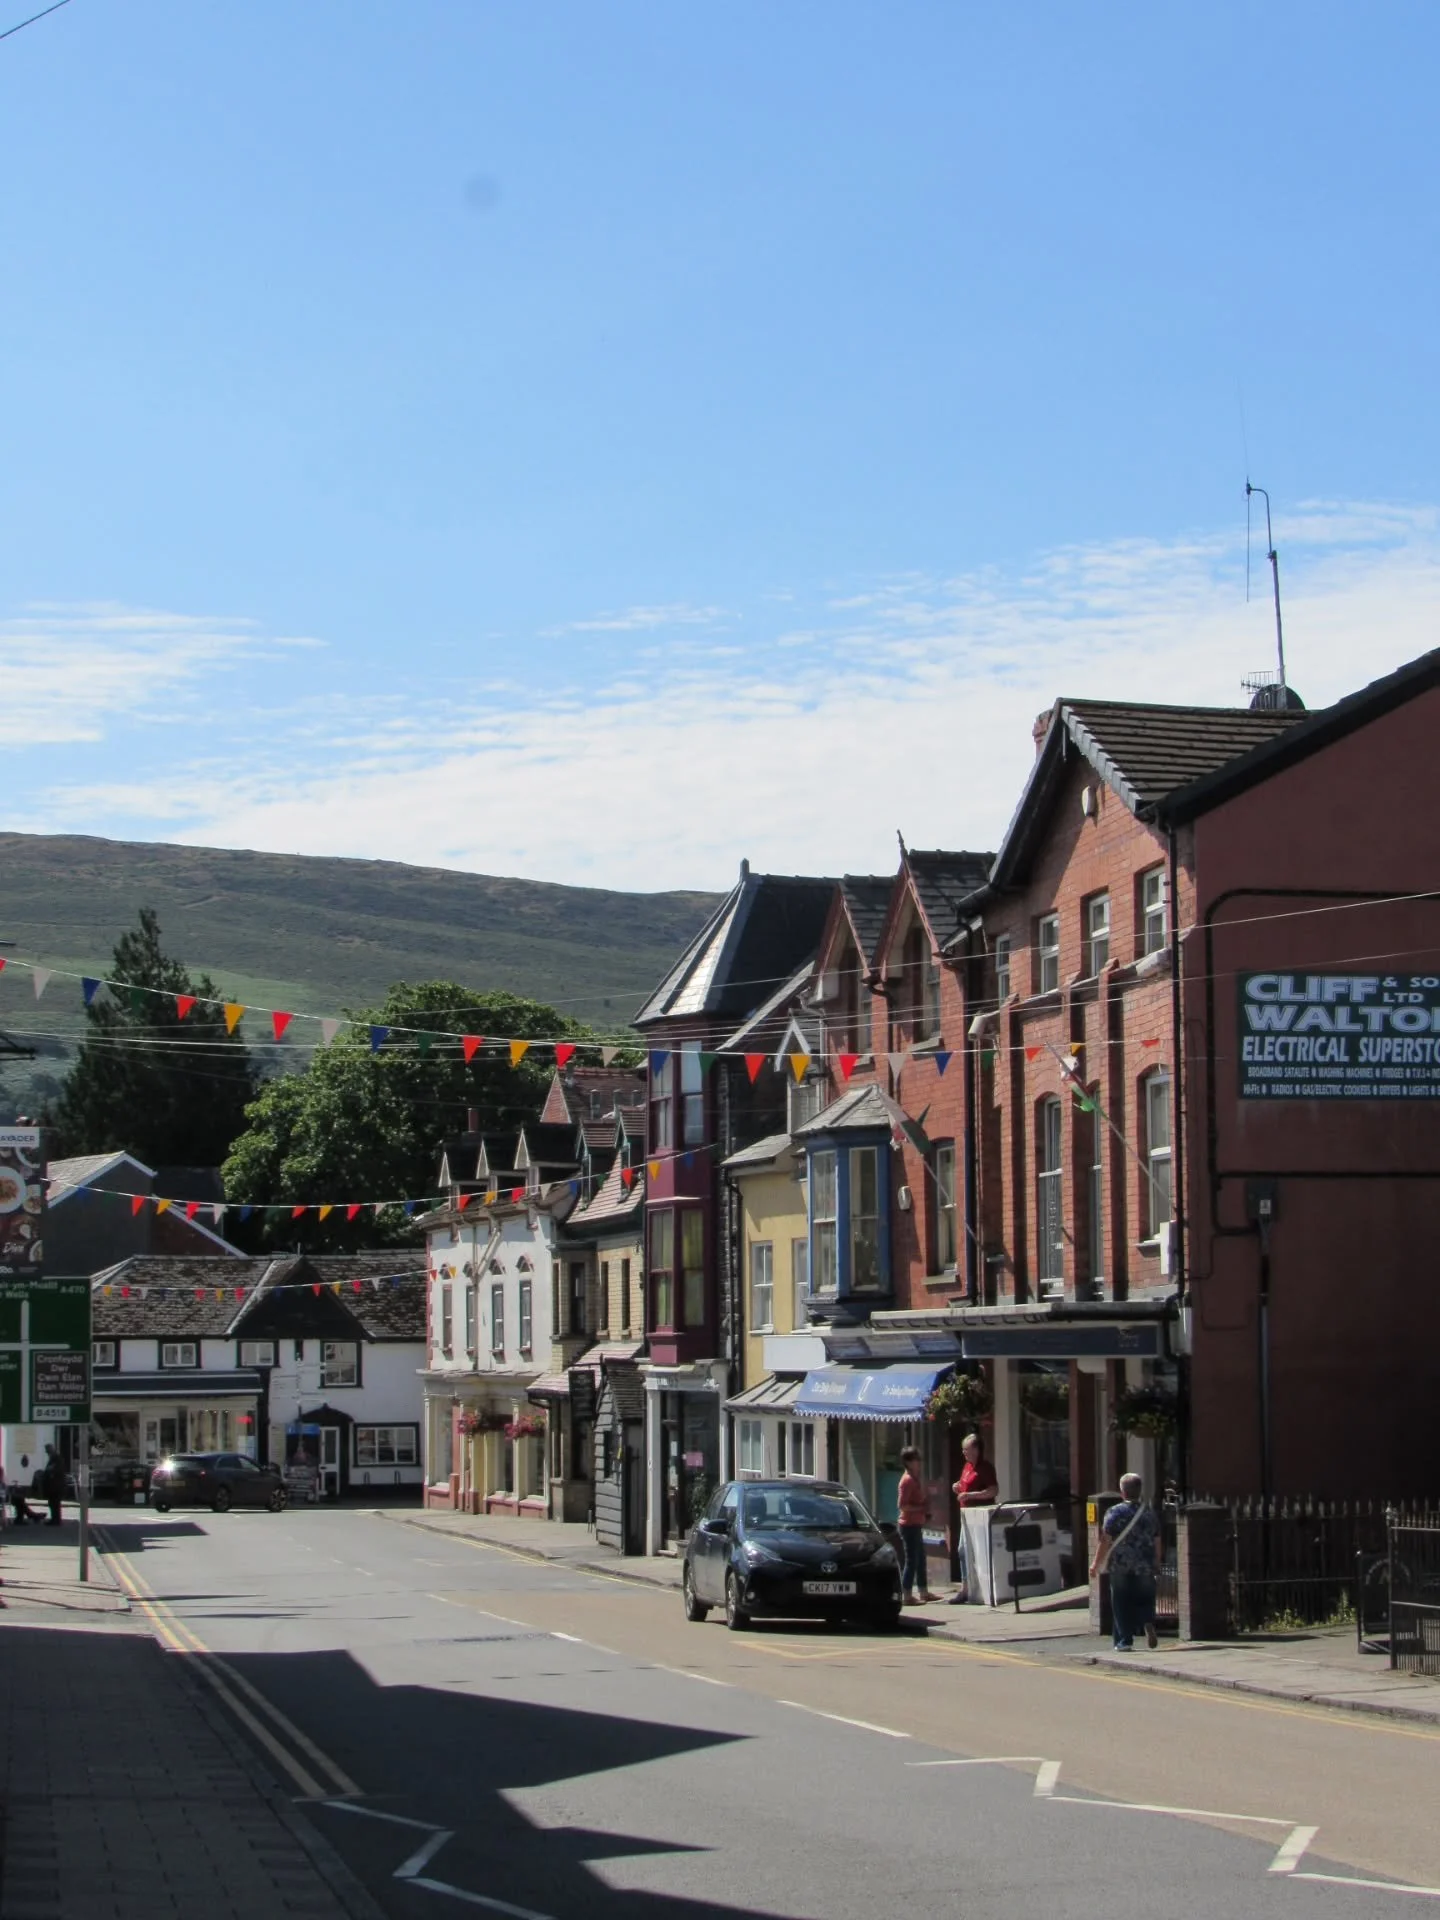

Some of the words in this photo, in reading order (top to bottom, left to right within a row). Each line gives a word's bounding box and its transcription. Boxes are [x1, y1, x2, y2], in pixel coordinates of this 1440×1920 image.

[1245, 974, 1379, 1003] CLIFF
[1382, 976, 1398, 988] &
[1382, 992, 1425, 1003] LTD
[1242, 1036, 1350, 1062] ELECTRICAL
[1247, 1066, 1283, 1078] BROADBAND
[1318, 1067, 1344, 1078] WASHING
[1345, 1067, 1374, 1079] MACHINES
[1382, 1067, 1404, 1079] FRIDGES
[1343, 1084, 1371, 1096] COOKERS
[1379, 1085, 1401, 1096] DRYERS
[1408, 1084, 1429, 1096] LIGHTS
